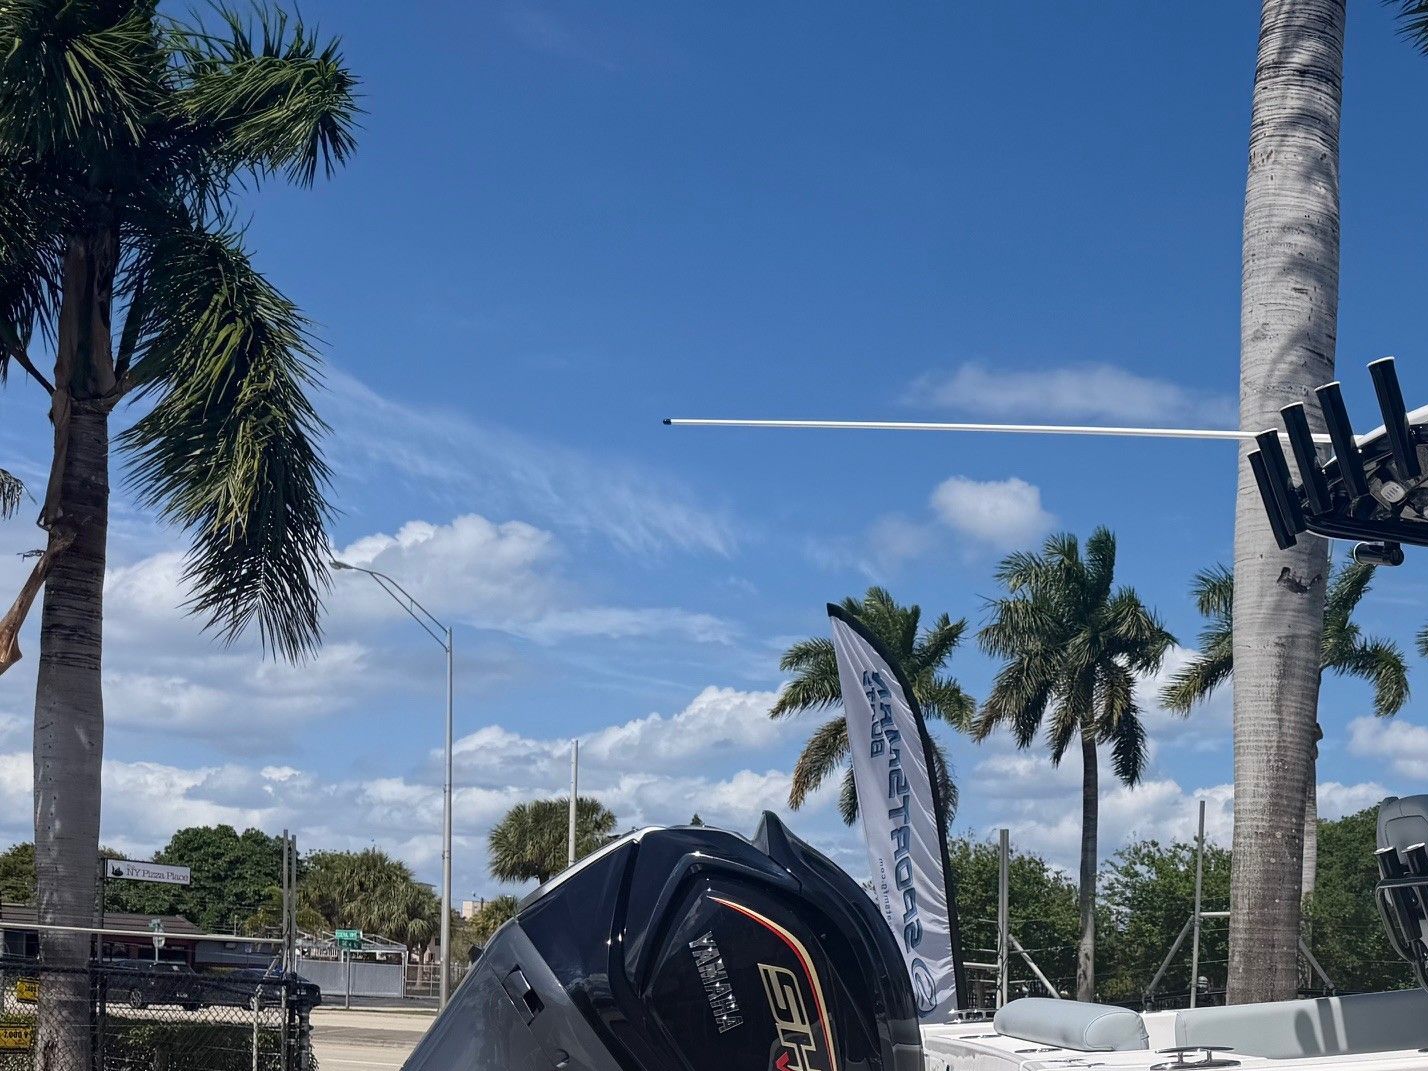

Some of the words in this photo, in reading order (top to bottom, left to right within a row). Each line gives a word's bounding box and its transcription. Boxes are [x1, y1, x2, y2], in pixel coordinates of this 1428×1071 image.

[126, 868, 141, 877] NY
[142, 869, 165, 880] Pizza
[166, 871, 189, 882] Place
[688, 930, 744, 1035] YAMAHA
